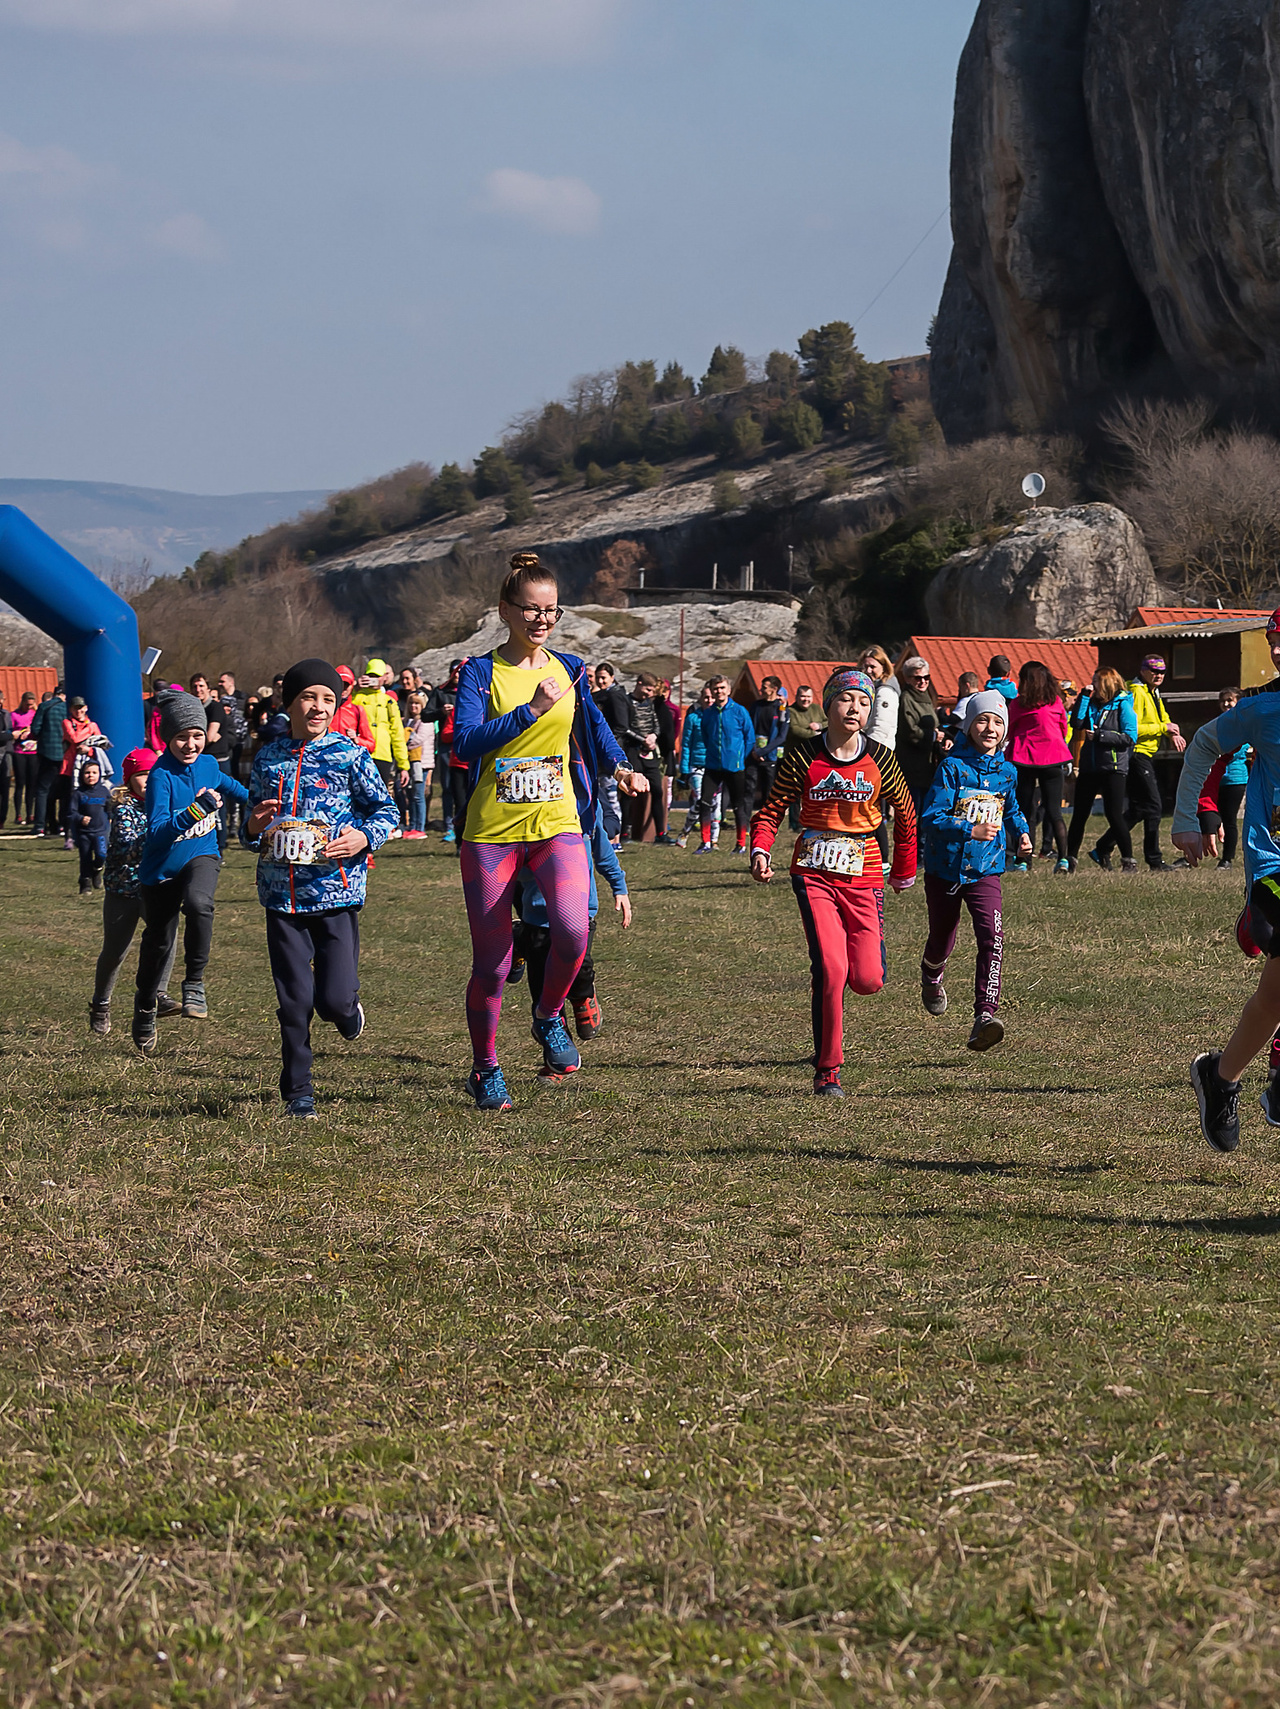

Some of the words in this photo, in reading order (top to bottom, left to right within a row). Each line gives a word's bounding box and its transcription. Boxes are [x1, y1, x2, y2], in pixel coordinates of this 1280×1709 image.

[511, 769, 551, 800] 005
[273, 829, 315, 861] 003
[812, 839, 851, 871] 006
